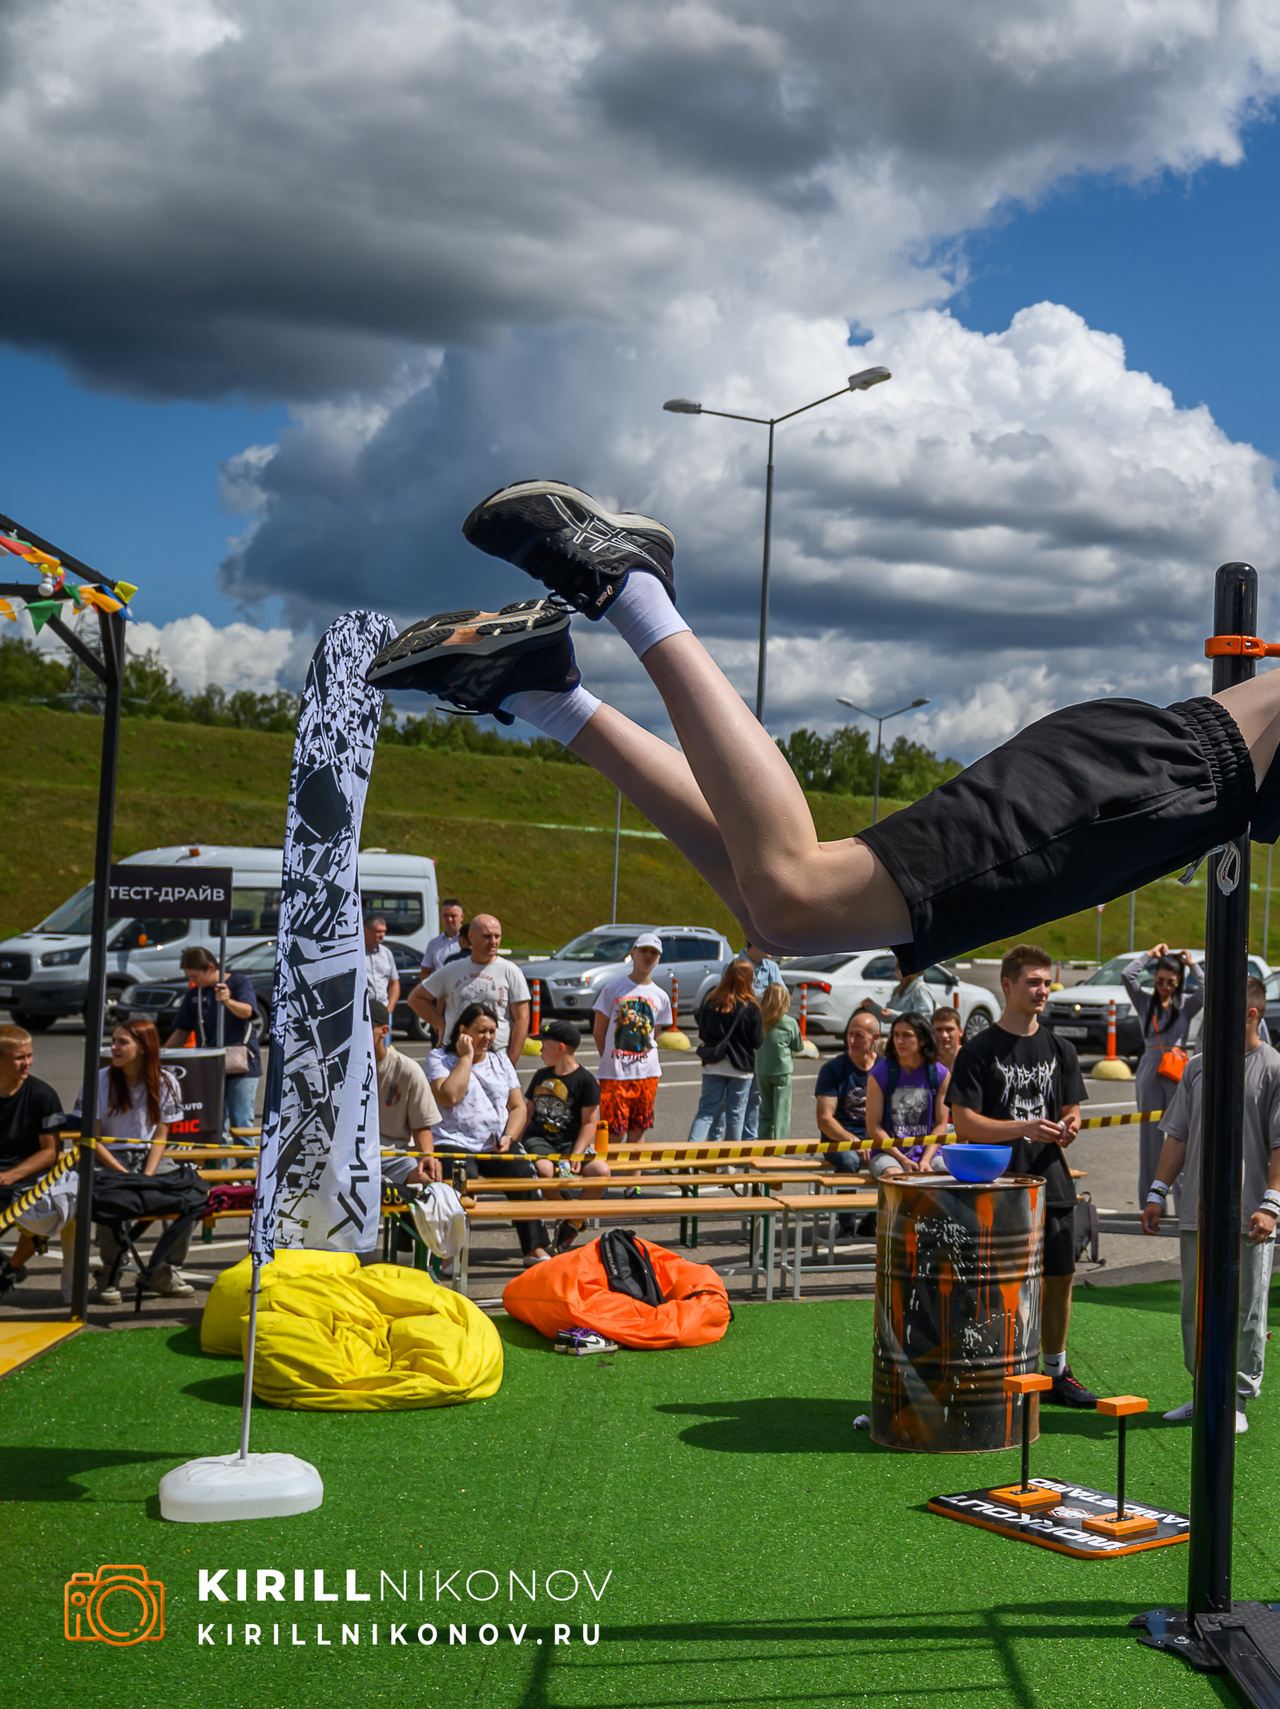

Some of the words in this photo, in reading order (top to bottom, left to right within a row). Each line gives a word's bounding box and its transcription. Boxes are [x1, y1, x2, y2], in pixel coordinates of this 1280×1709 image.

[108, 885, 226, 903] ТЕСТ-ДРАЙВ
[183, 1102, 203, 1111] UTO
[167, 1119, 200, 1135] AIC
[938, 1494, 1128, 1551] WORKOUT
